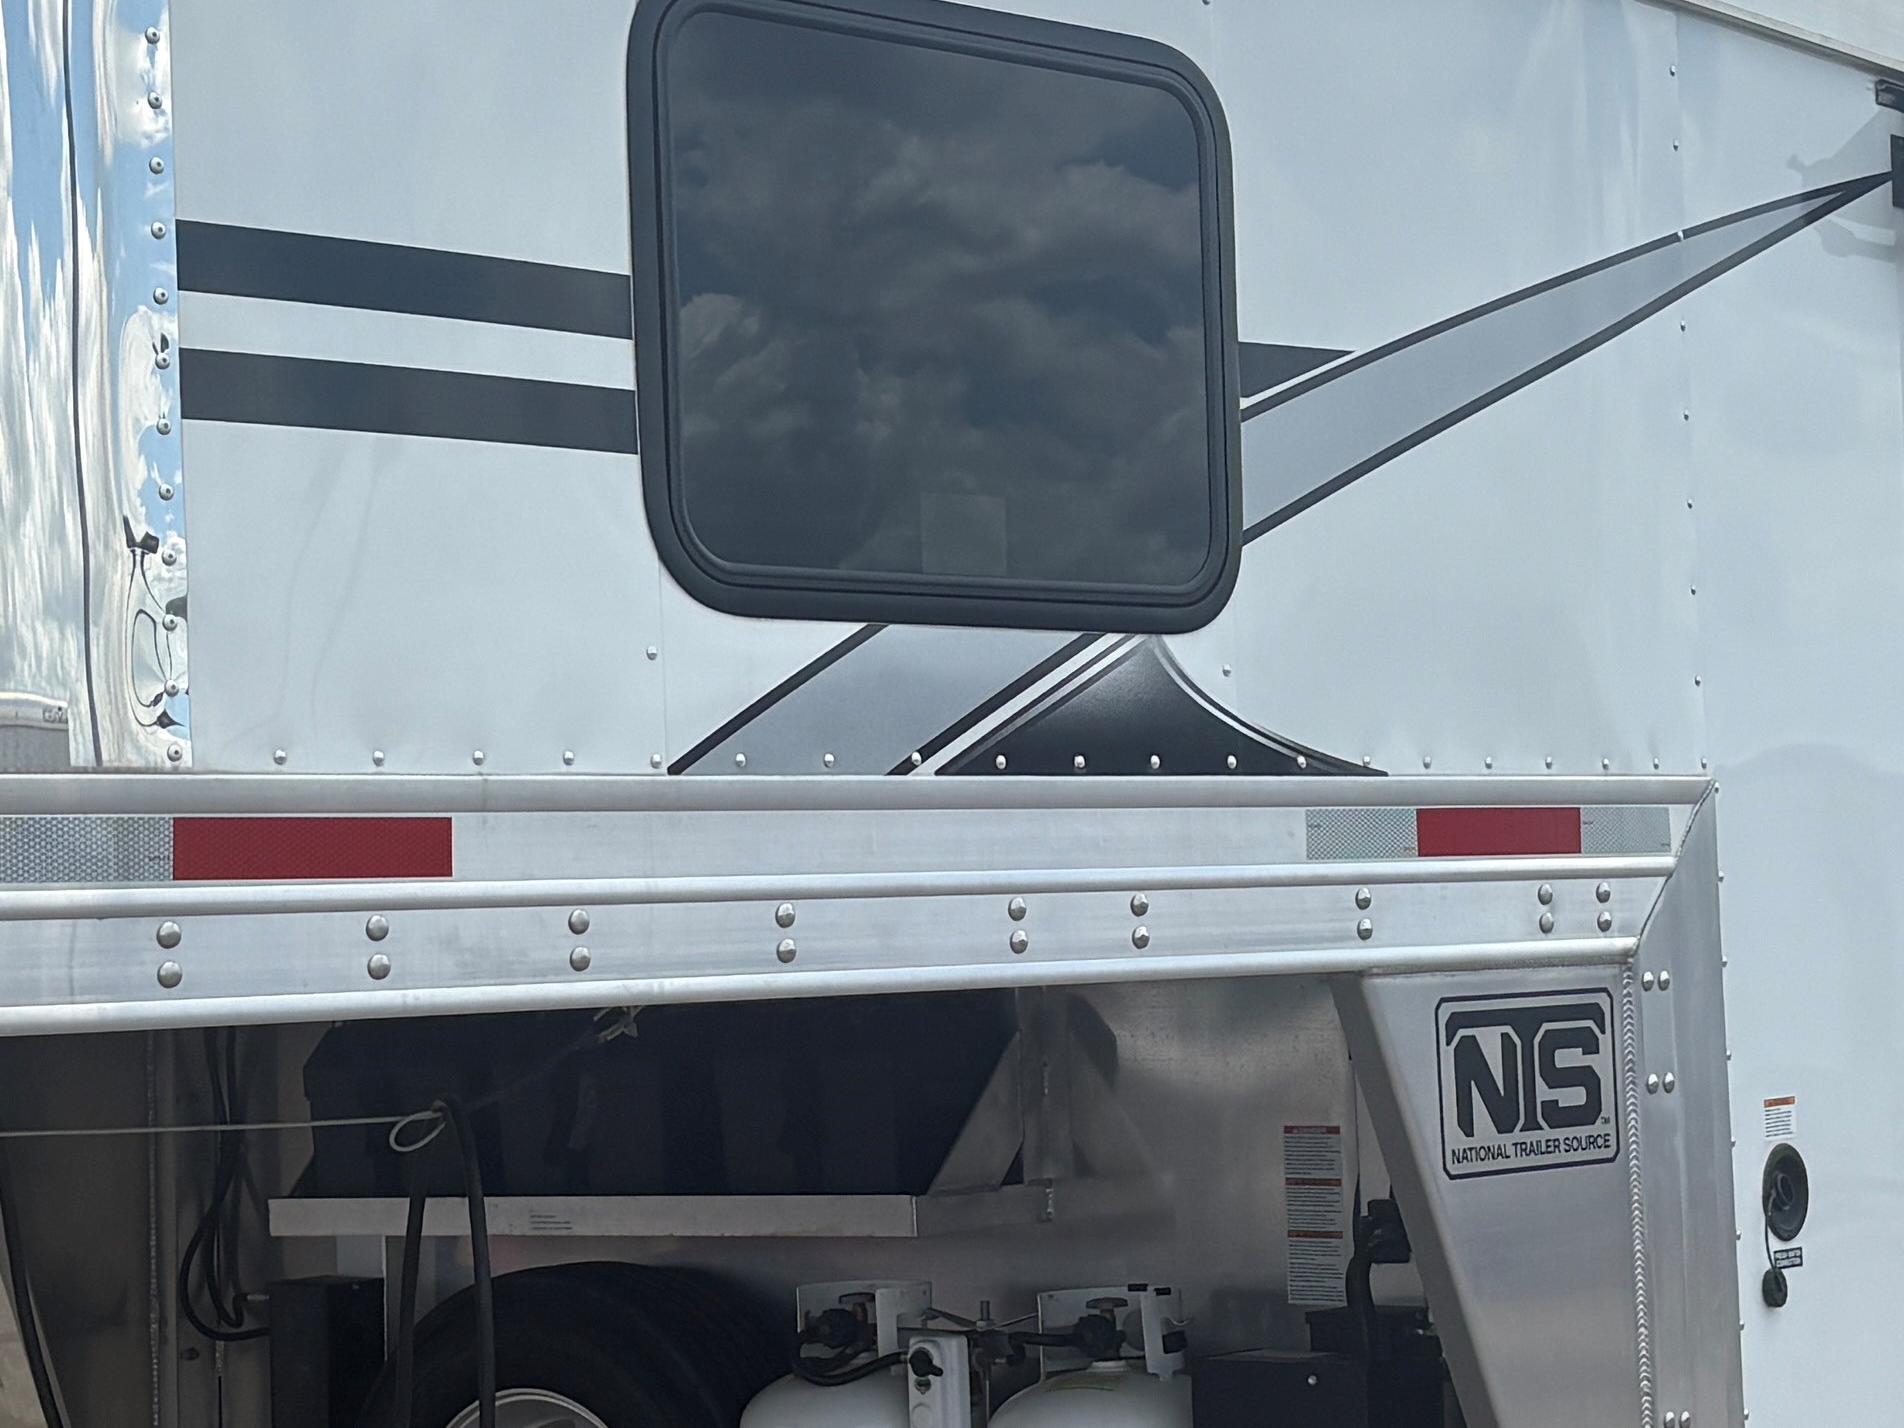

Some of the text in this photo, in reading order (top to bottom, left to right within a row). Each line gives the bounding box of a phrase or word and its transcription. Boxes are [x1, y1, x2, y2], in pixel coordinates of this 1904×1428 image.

[1444, 1002, 1607, 1138] NTS
[1450, 1133, 1612, 1165] NATIONAL TRAILER SOURCE
